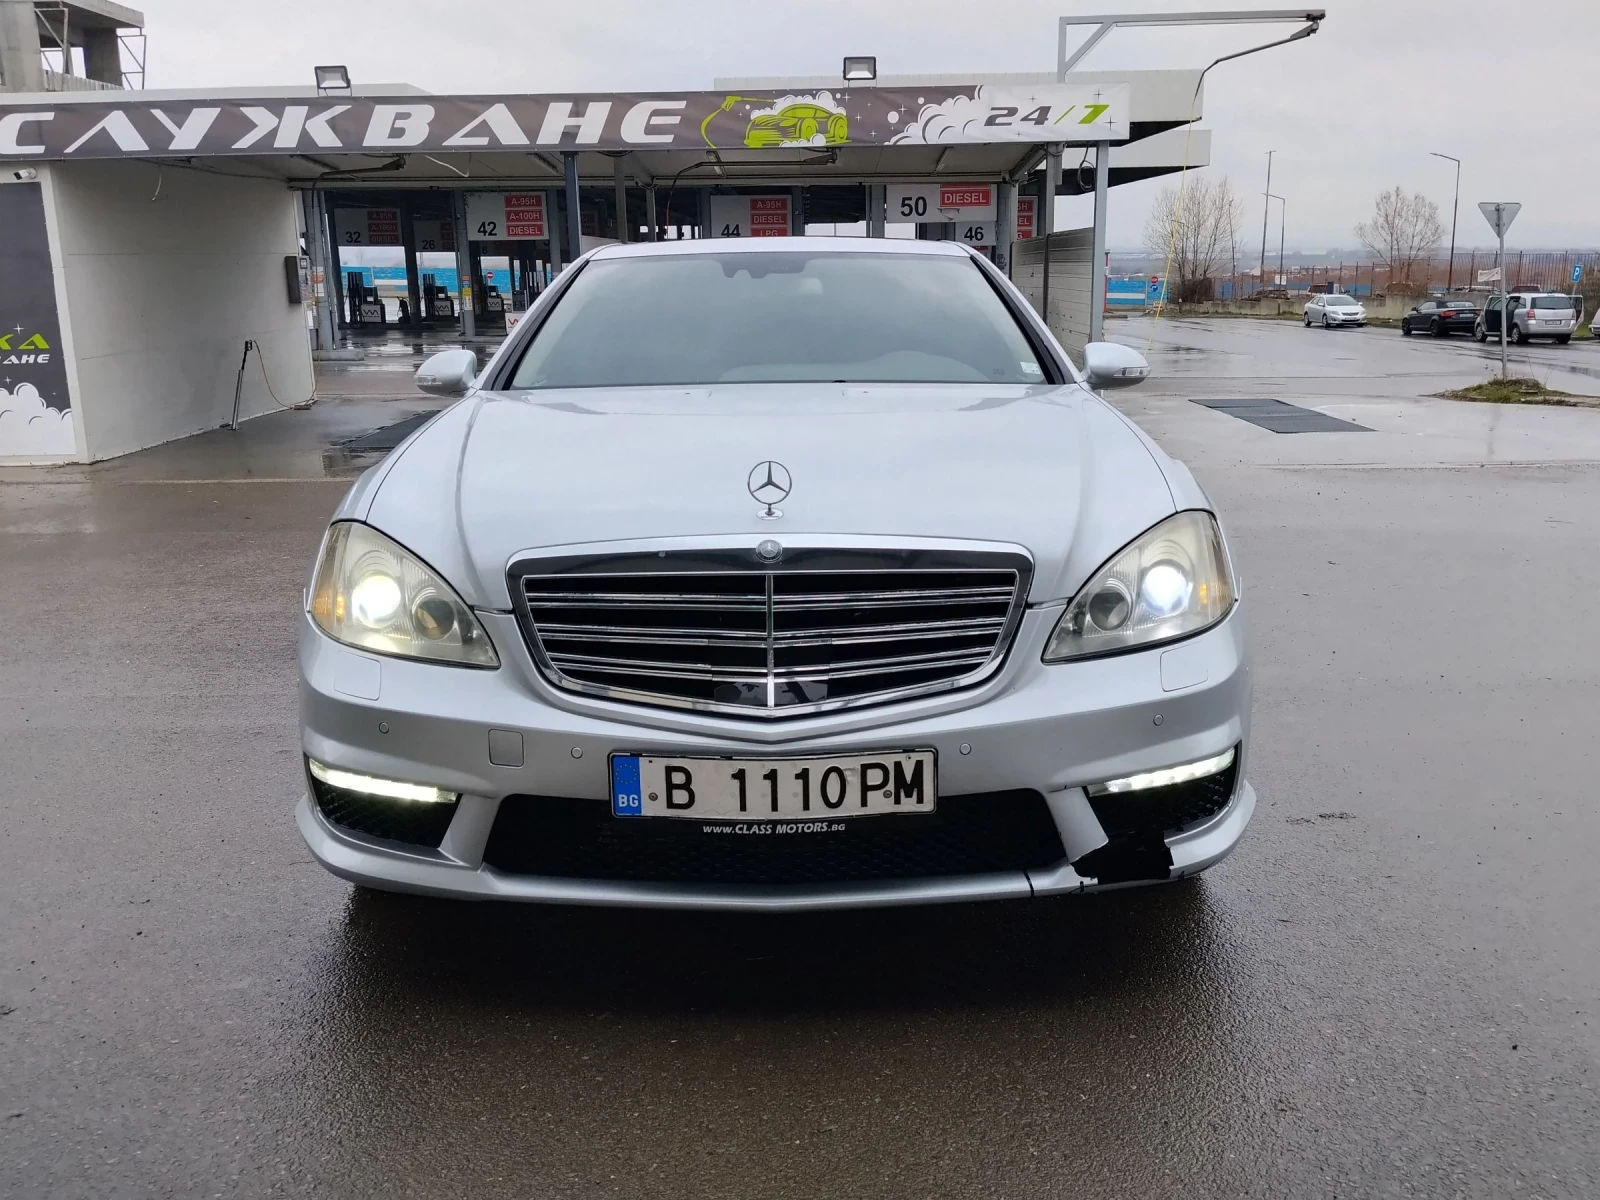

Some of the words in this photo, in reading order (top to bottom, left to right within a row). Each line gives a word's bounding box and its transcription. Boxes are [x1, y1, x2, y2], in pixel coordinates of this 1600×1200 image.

[984, 104, 1110, 127] 24/7
[0, 101, 687, 154] СЛУЖВАНЕ
[511, 197, 536, 205] A-95H
[756, 201, 782, 209] A-95H
[944, 193, 987, 204] DIESEL
[900, 196, 928, 217] 50
[509, 212, 540, 220] A-100H
[753, 215, 785, 223] DIESEL
[477, 221, 498, 236] 42
[509, 226, 541, 235] DIESEL
[721, 223, 741, 237] 44
[963, 226, 984, 241] 46
[345, 231, 362, 244] 32
[371, 235, 397, 243] DIESEL
[421, 239, 436, 250] 26
[1573, 267, 1580, 280] P
[665, 765, 696, 810] B
[731, 765, 848, 812] 1110
[860, 759, 925, 808] PM
[618, 794, 639, 807] BG
[775, 822, 846, 834] MOTORS.BG
